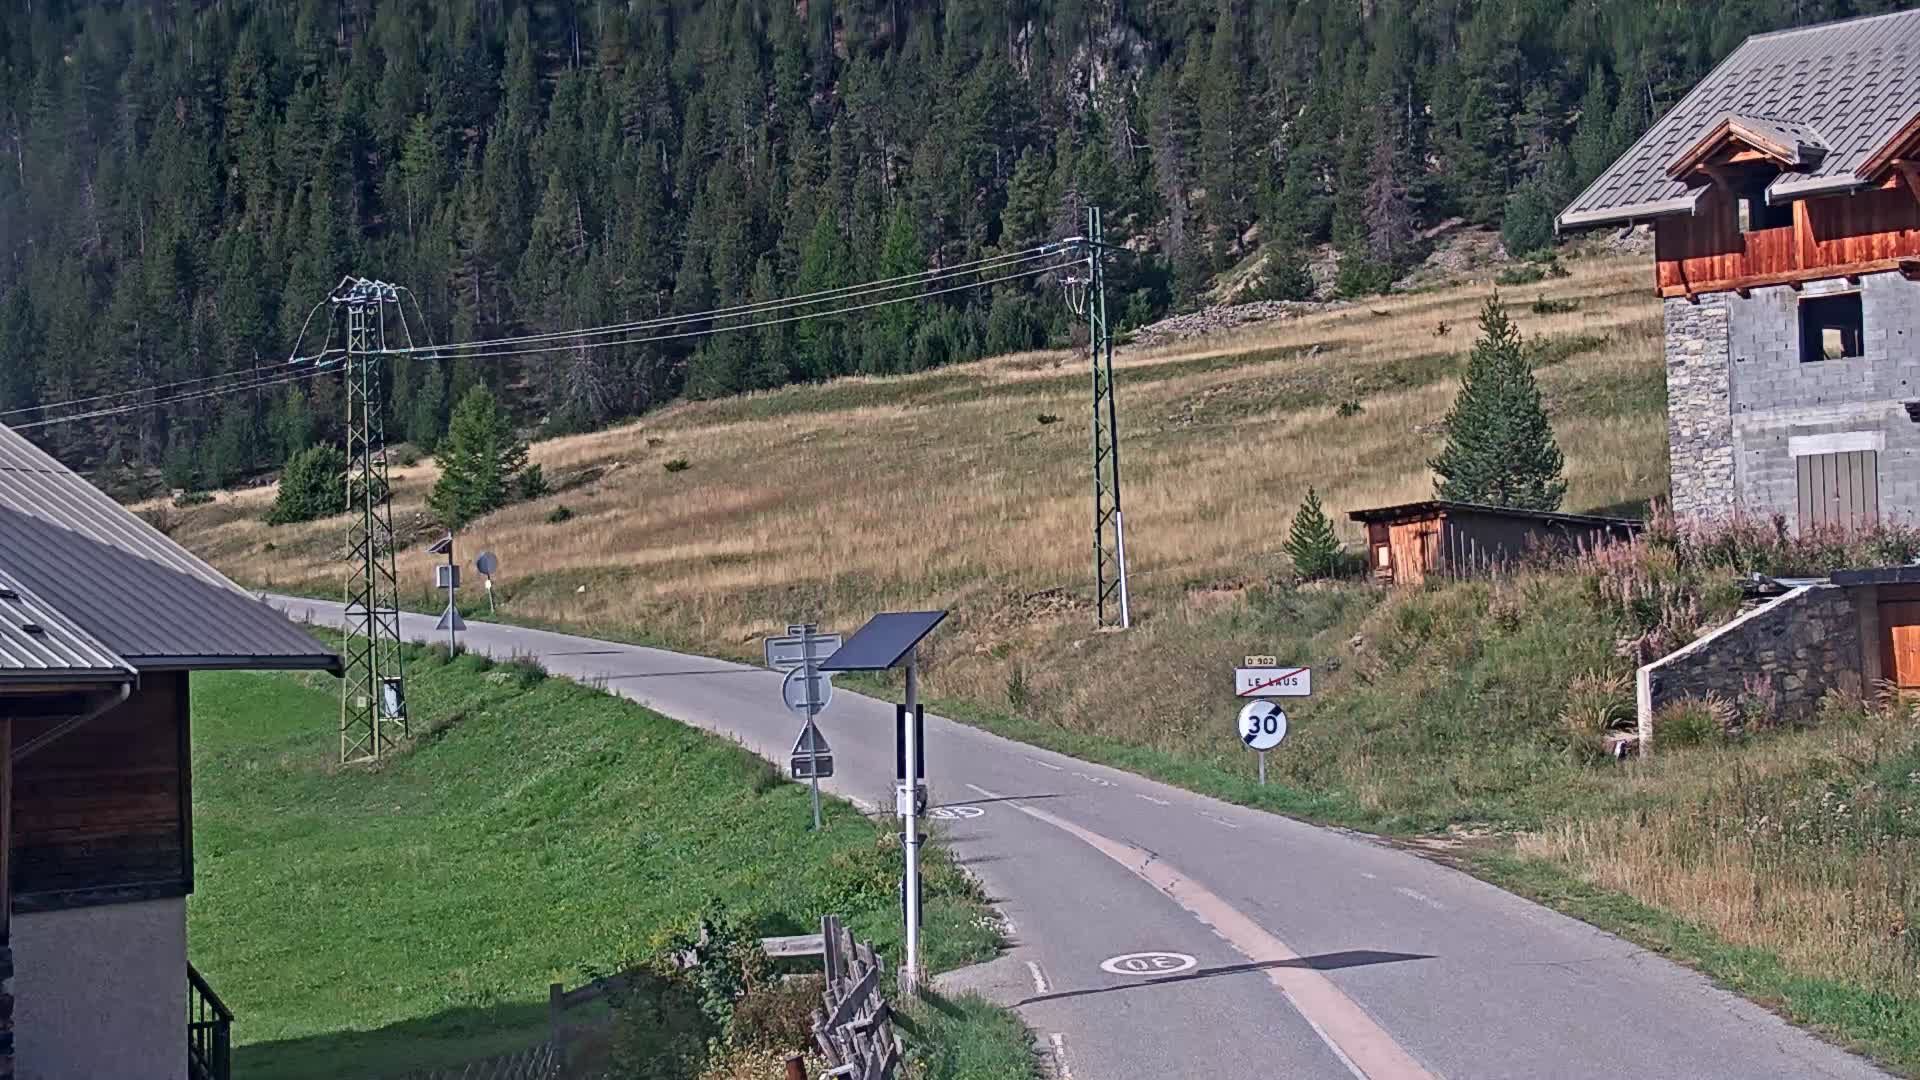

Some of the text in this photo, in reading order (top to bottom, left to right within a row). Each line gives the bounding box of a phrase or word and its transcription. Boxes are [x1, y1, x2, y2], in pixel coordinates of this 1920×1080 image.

[1248, 677, 1298, 687] LE LAUS
[1248, 715, 1278, 735] 30
[1125, 956, 1176, 971] 30
